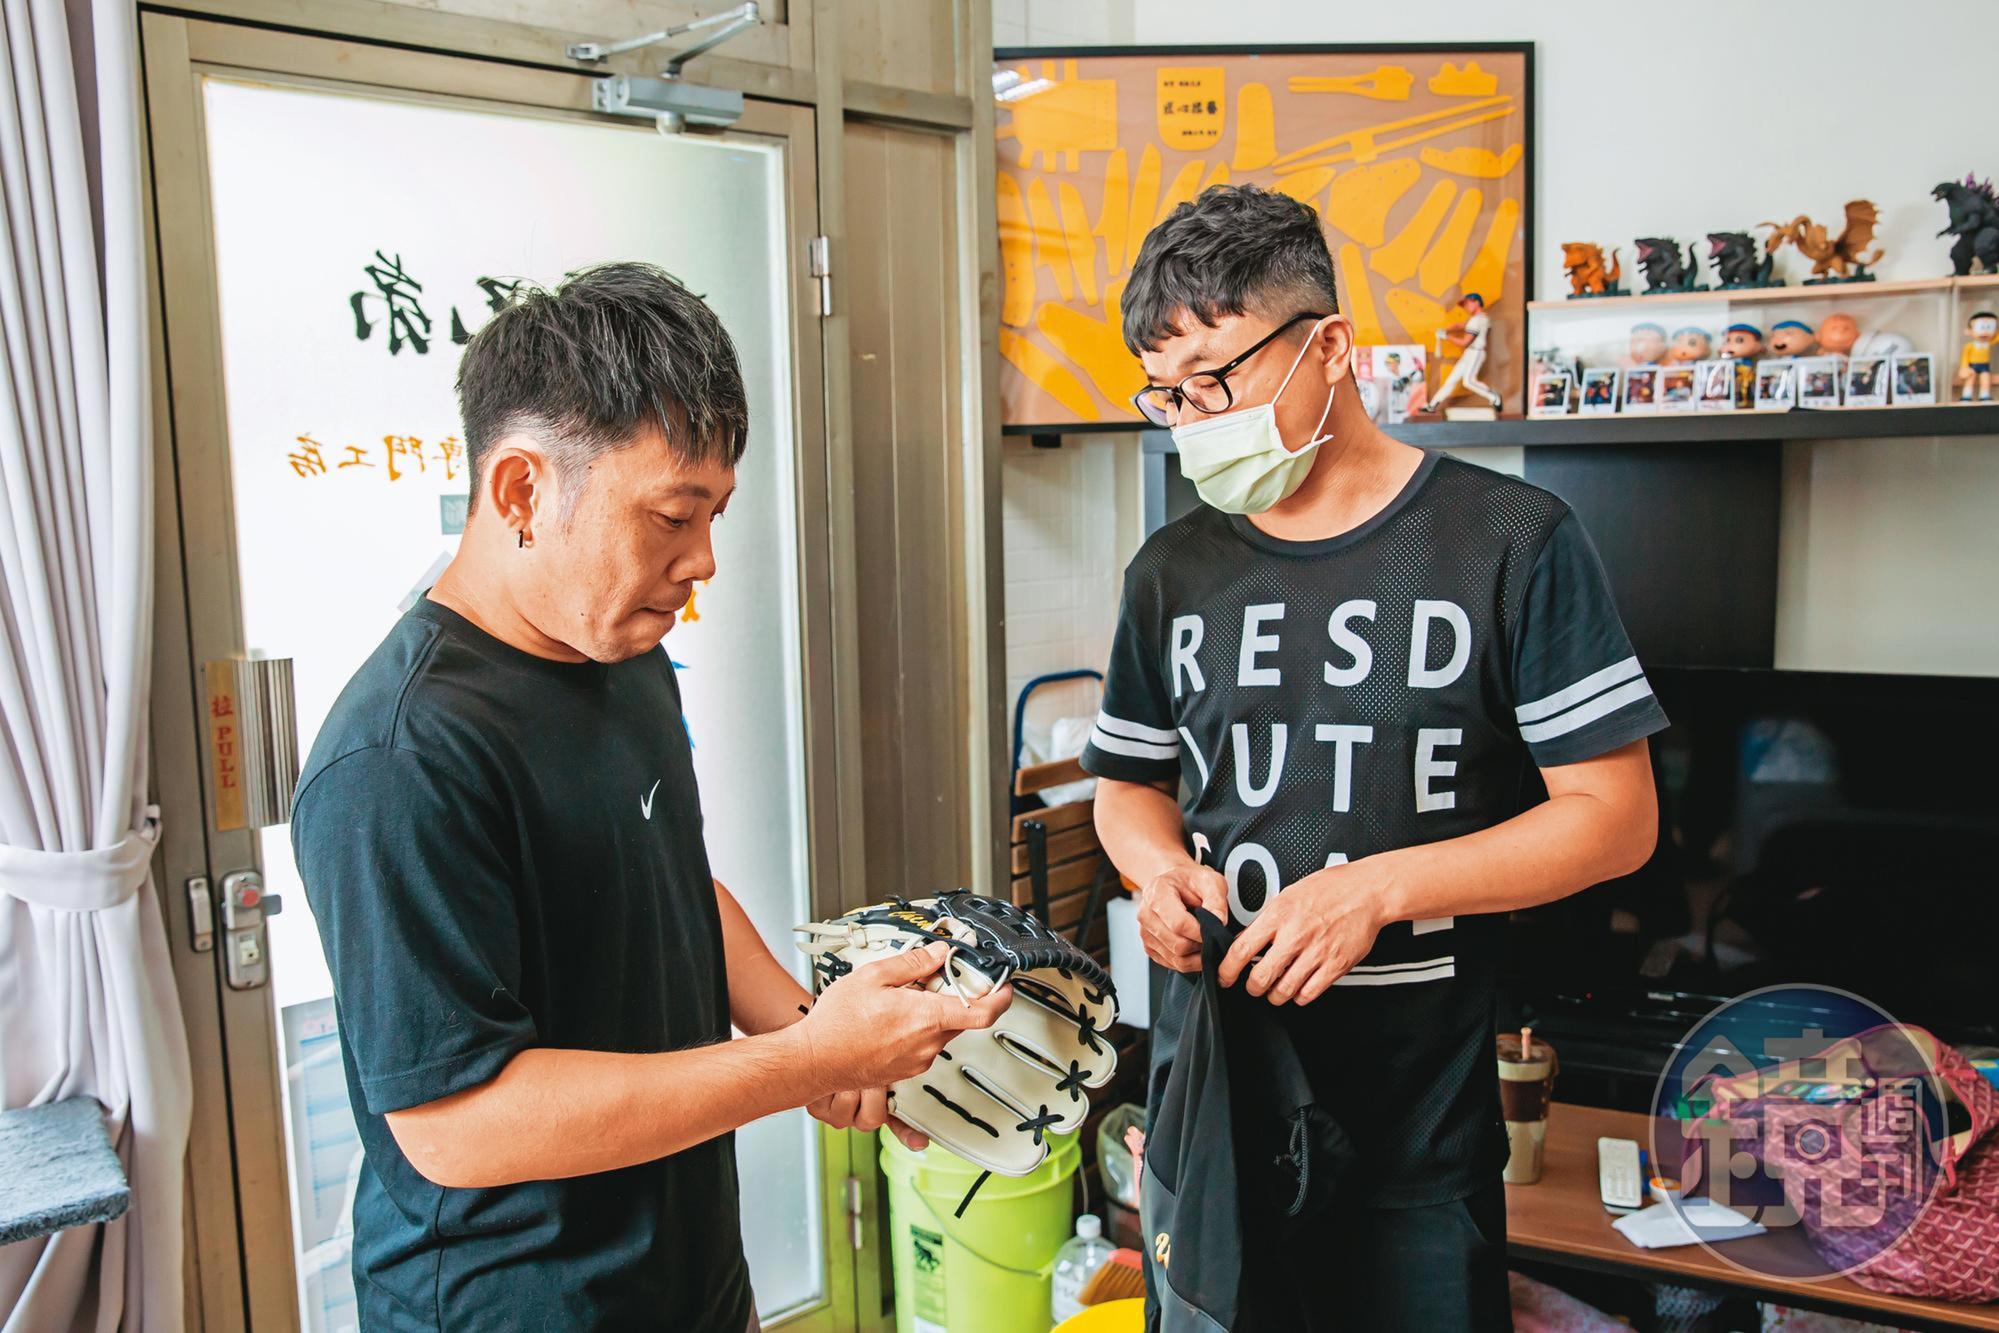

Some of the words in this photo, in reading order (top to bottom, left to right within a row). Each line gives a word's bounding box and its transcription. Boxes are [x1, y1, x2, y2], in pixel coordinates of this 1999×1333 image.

[1170, 599, 1472, 698] RESD
[211, 695, 234, 717] 拉
[216, 727, 236, 790] PULL
[1178, 722, 1463, 813] UTE
